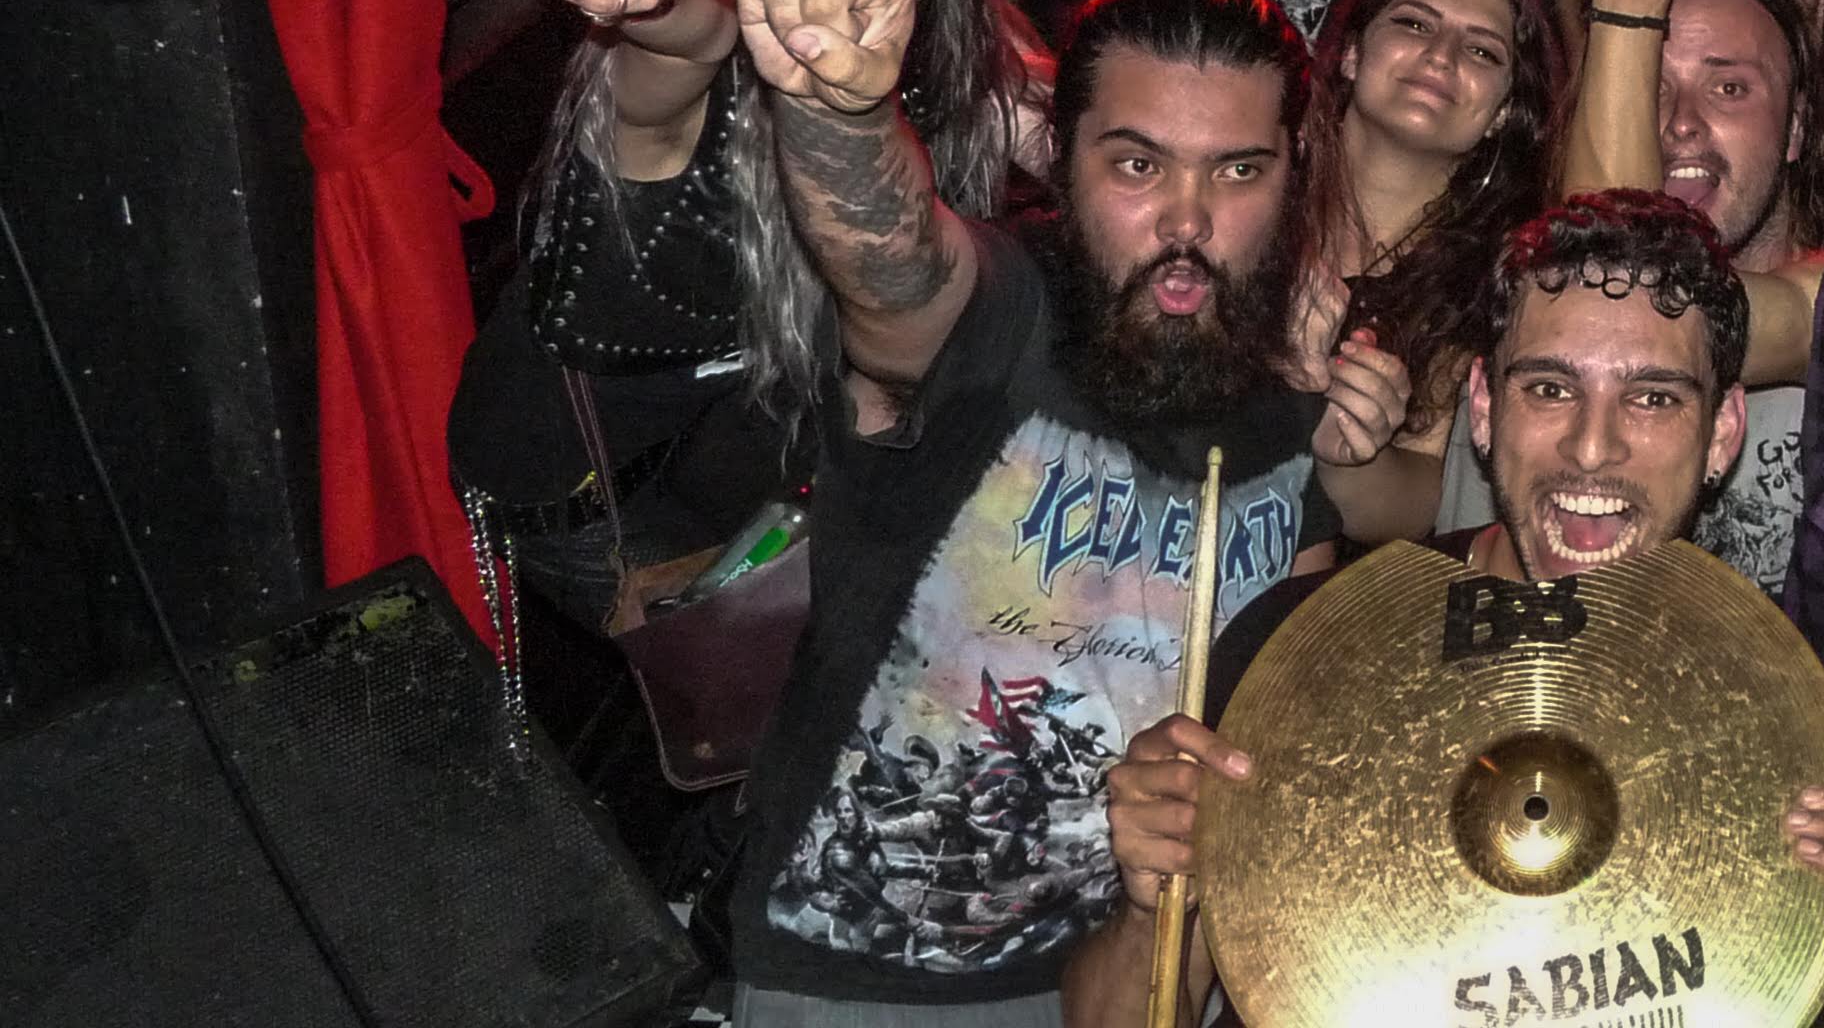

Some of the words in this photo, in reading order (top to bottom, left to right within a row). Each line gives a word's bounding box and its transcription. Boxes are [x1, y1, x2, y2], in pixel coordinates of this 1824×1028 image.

[1153, 486, 1302, 614] ERTH
[989, 605, 1040, 636] the
[1453, 925, 1707, 1028] SABIAN
